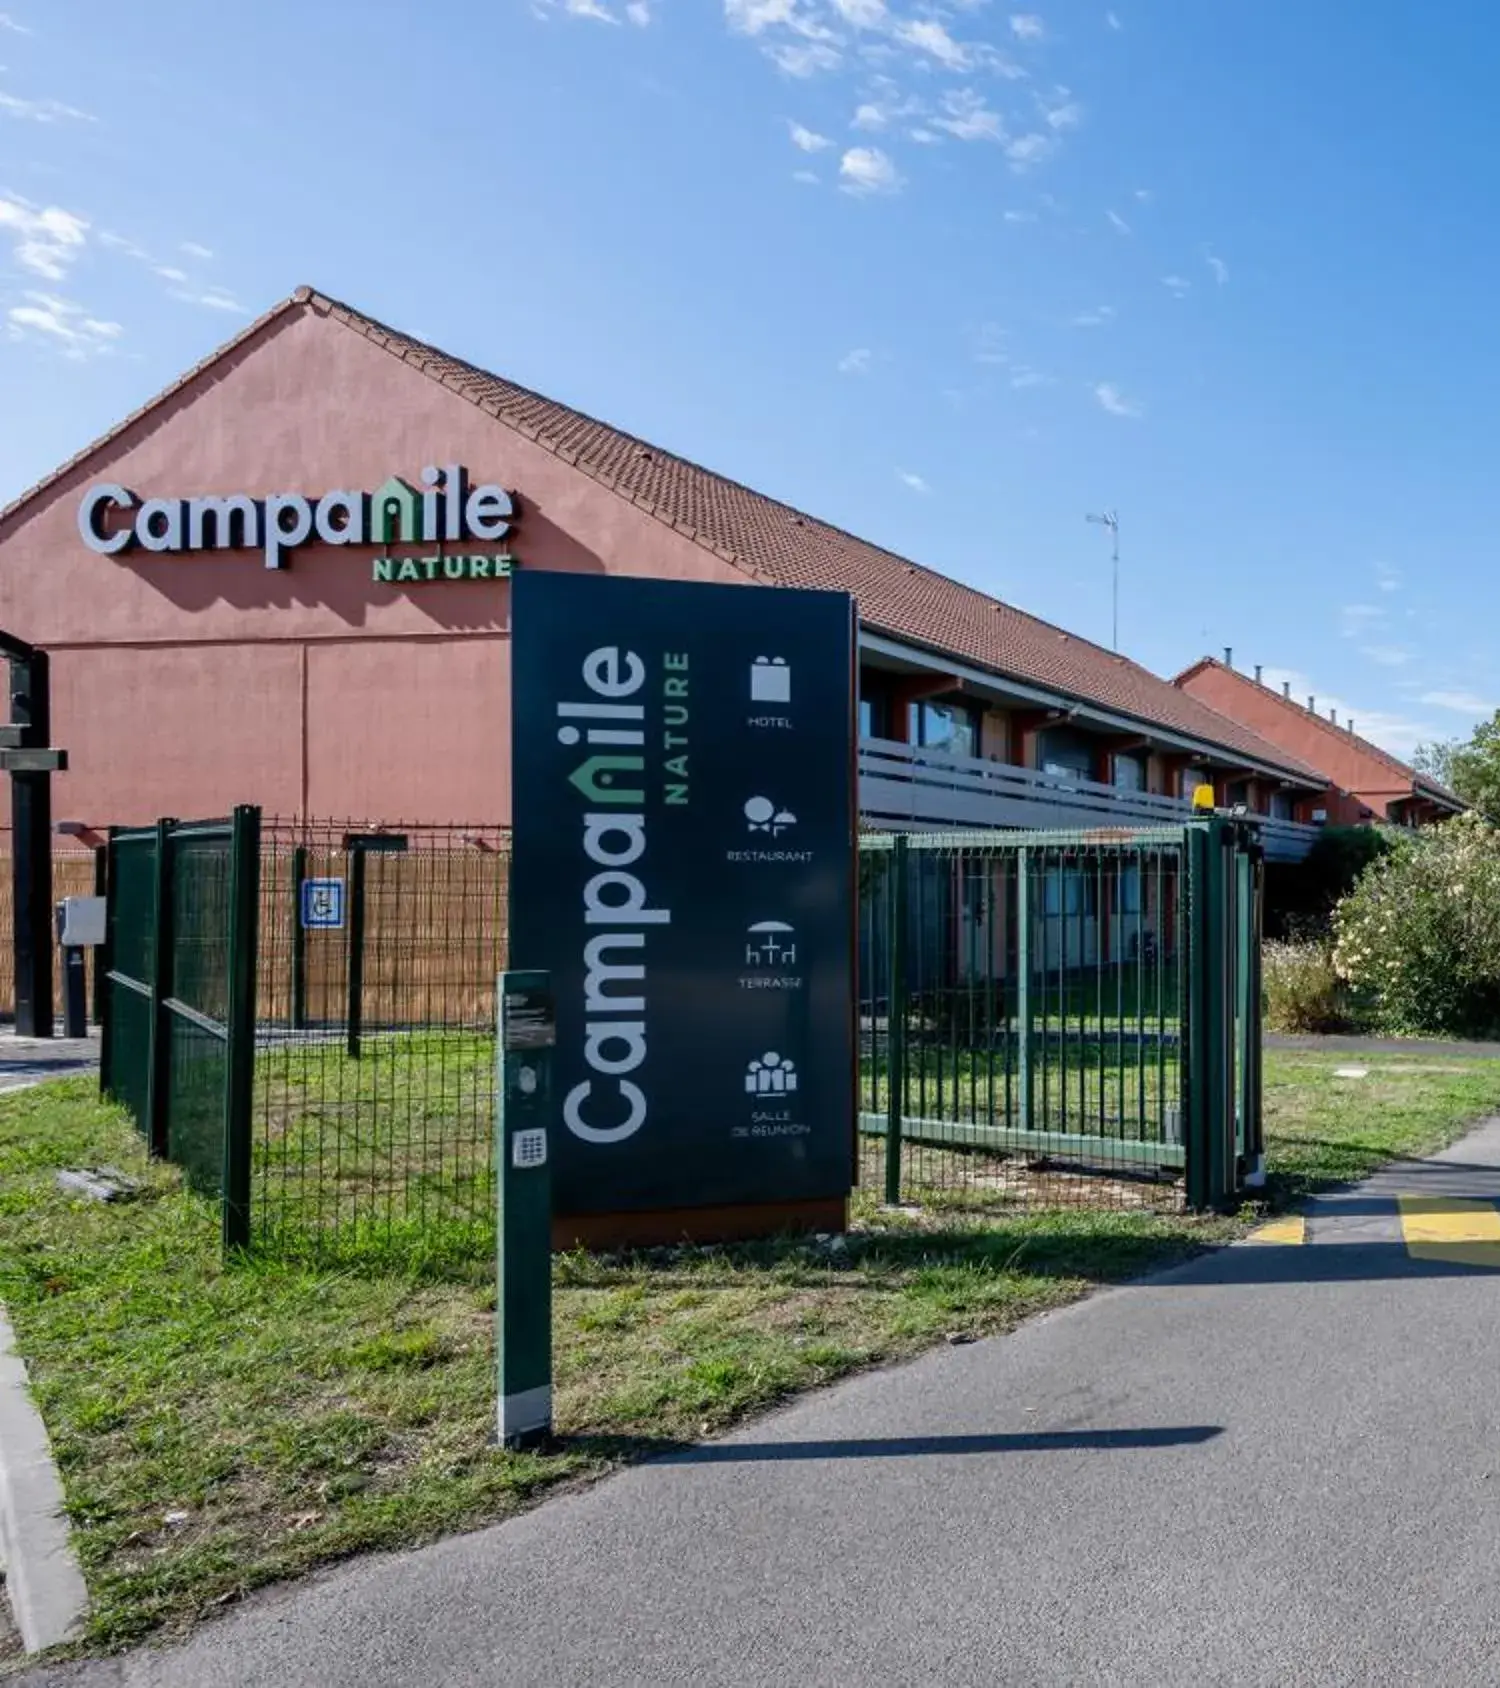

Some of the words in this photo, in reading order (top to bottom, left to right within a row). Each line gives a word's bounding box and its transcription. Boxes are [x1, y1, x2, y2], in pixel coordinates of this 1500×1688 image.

[78, 465, 515, 569] Campanile
[372, 554, 513, 581] NATURE
[664, 653, 689, 805] NATURE
[726, 851, 813, 862] RESTAURANT
[557, 646, 671, 1143] Campanile
[752, 1110, 791, 1122] SALLE
